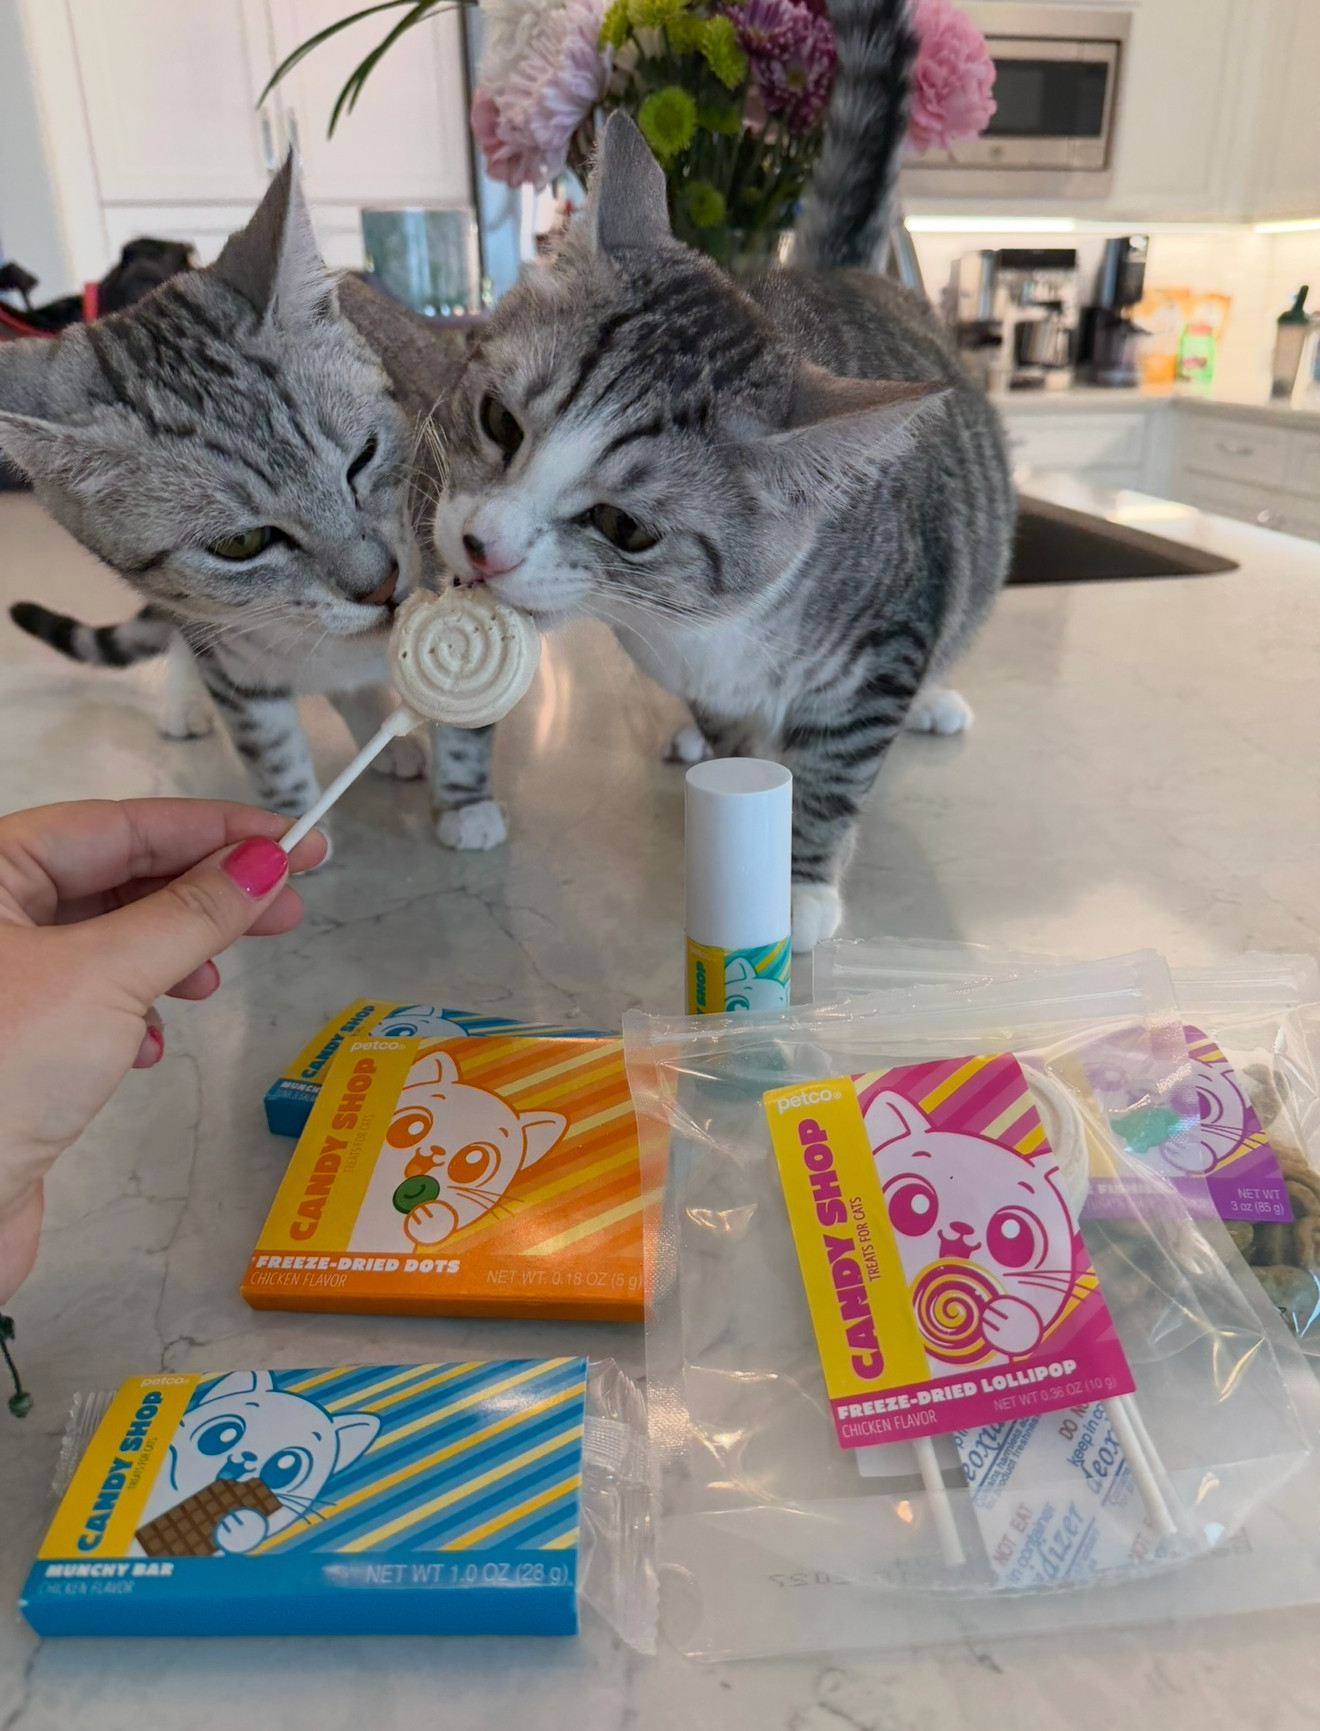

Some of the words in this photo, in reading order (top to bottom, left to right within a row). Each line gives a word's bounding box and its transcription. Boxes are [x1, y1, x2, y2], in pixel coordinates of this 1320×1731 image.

[301, 1033, 345, 1079] CANDY
[340, 1005, 375, 1033] SHOP
[289, 1135, 348, 1241] CANDY
[332, 1058, 377, 1130] SHOP
[798, 1118, 848, 1227] SHOP
[849, 1196, 865, 1220] CATS
[1230, 1200, 1239, 1211] 3
[1240, 1203, 1253, 1211] oz
[1255, 1201, 1271, 1214] (85
[1273, 1202, 1285, 1216] g)
[1238, 1188, 1260, 1199] NET
[1262, 1189, 1280, 1200] WT
[855, 1222, 872, 1246] FOR
[255, 1255, 400, 1272] FREEZE-DRIED
[404, 1259, 460, 1274] DOTS
[862, 1246, 881, 1283] TREATS
[250, 1272, 299, 1286] CHICKEN
[303, 1273, 348, 1287] FLAVOR
[486, 1269, 517, 1284] NET
[552, 1271, 582, 1286] 0.18
[586, 1271, 609, 1287] OZ
[611, 1273, 625, 1288] (5
[628, 1274, 643, 1290] g)
[823, 1233, 884, 1381] CANDY
[837, 1381, 978, 1420] FREEZE-DRIED
[982, 1359, 1078, 1393] LOLLIPOP
[993, 1396, 1016, 1412] NET
[1019, 1391, 1038, 1406] WT
[1065, 1381, 1084, 1396] OZ
[1084, 1377, 1103, 1393] (10
[1105, 1374, 1117, 1390] g)
[842, 1419, 892, 1438] CHICKEN
[895, 1409, 938, 1430] FLAVOR
[1057, 1417, 1078, 1440] DO
[1066, 1432, 1093, 1467] keep
[77, 1457, 133, 1552] CANDY
[119, 1391, 163, 1453] SHOP
[991, 1532, 1016, 1566] NOT
[1009, 1501, 1033, 1534] EAT
[45, 1563, 130, 1578] MUNCHY
[131, 1562, 174, 1577] BAR
[367, 1564, 408, 1584] NET
[412, 1563, 444, 1583] WT
[451, 1564, 478, 1583] 1.0
[482, 1562, 511, 1582] OZ
[516, 1563, 545, 1583] (28
[550, 1564, 569, 1586] g)
